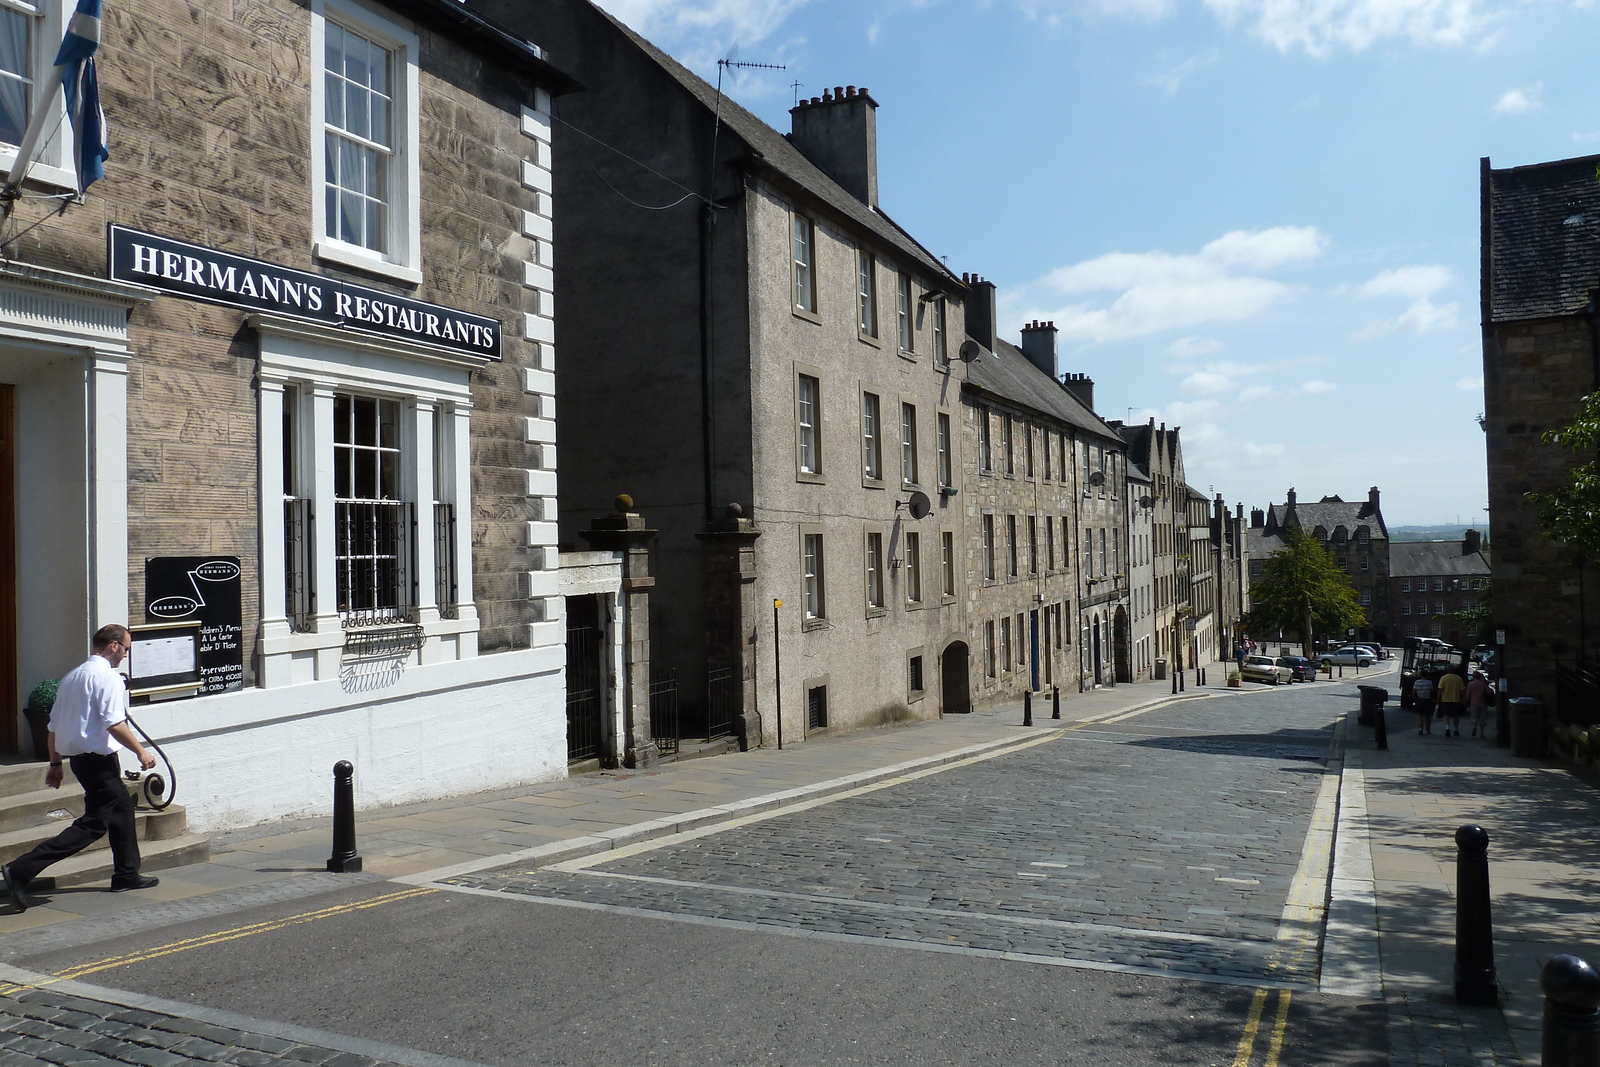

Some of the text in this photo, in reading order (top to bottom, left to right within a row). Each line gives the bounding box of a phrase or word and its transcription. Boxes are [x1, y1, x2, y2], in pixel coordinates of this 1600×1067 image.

[131, 243, 493, 348] HERMANN'S RESTAURANTS
[153, 602, 194, 611] HERMANN'S
[225, 624, 242, 632] Menu
[202, 634, 207, 642] A
[209, 634, 217, 642] La
[199, 643, 213, 652] able
